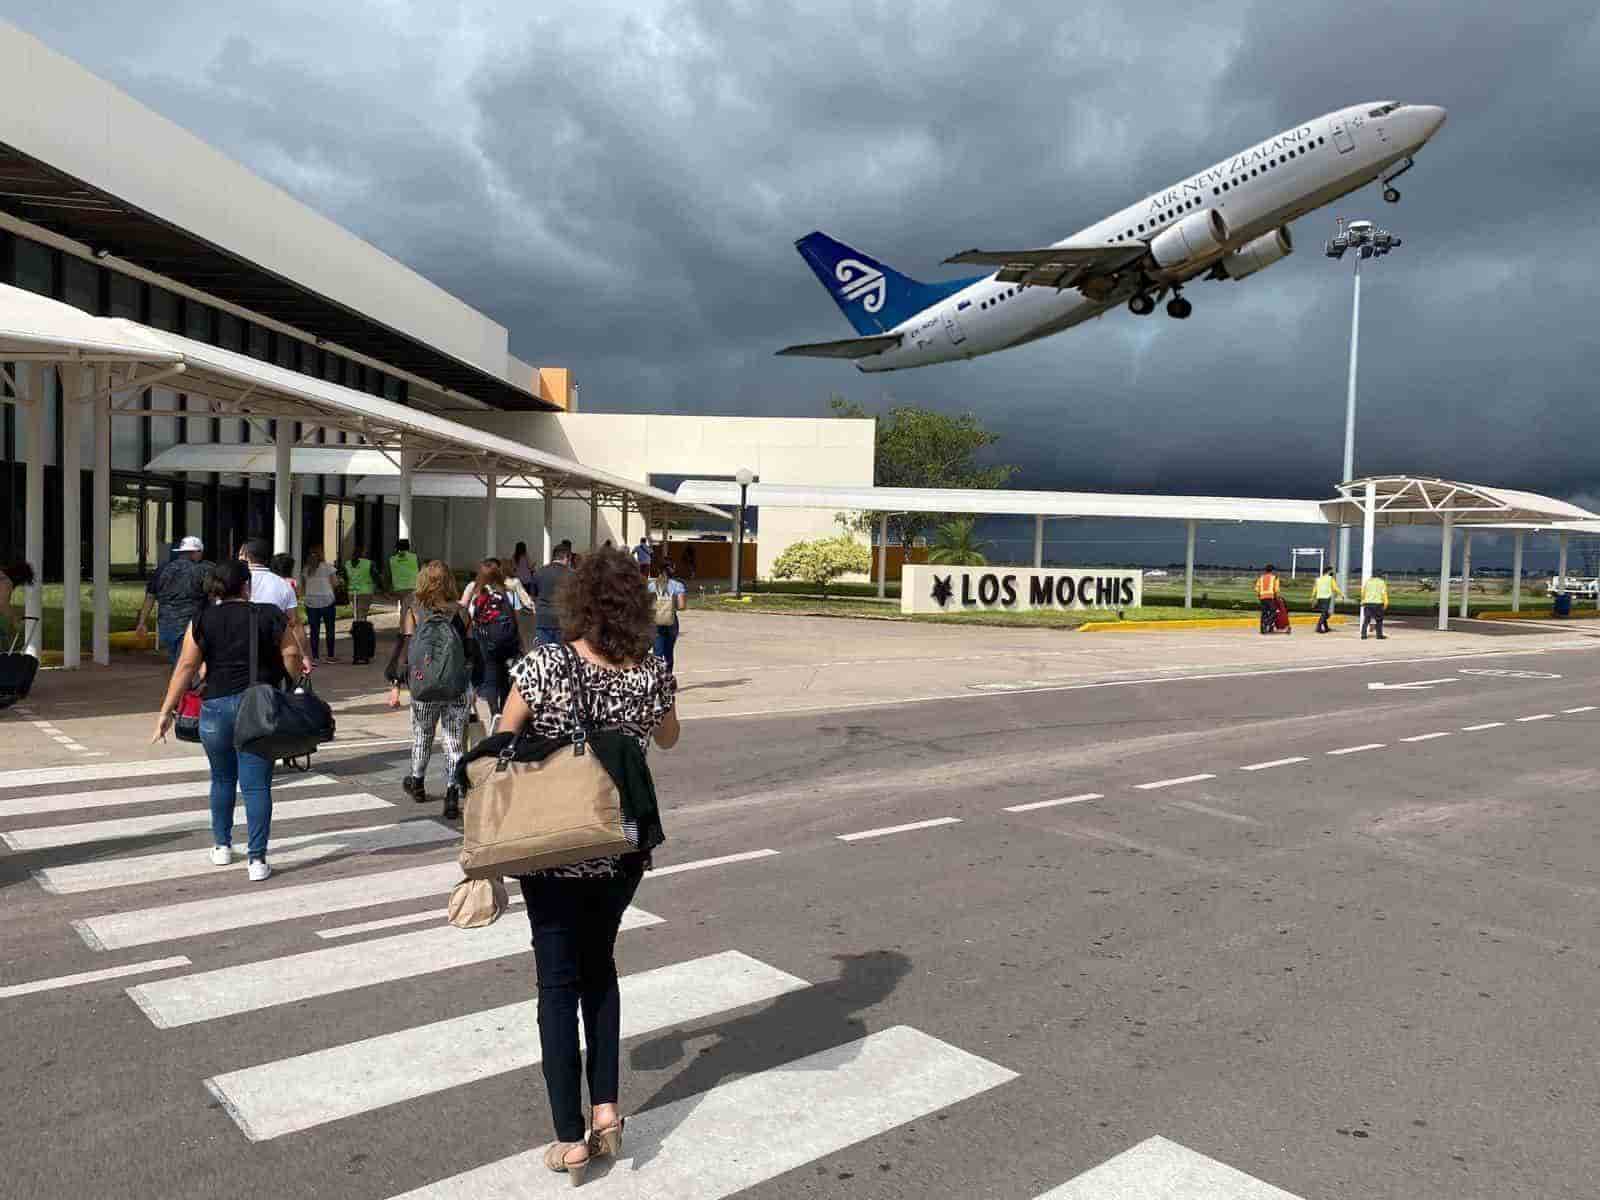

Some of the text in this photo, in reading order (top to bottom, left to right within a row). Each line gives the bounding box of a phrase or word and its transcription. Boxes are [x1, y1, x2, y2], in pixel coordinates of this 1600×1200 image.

[1150, 127, 1312, 211] AIR NEW ZEALAND
[961, 574, 1135, 606] LOS MOCHIS
